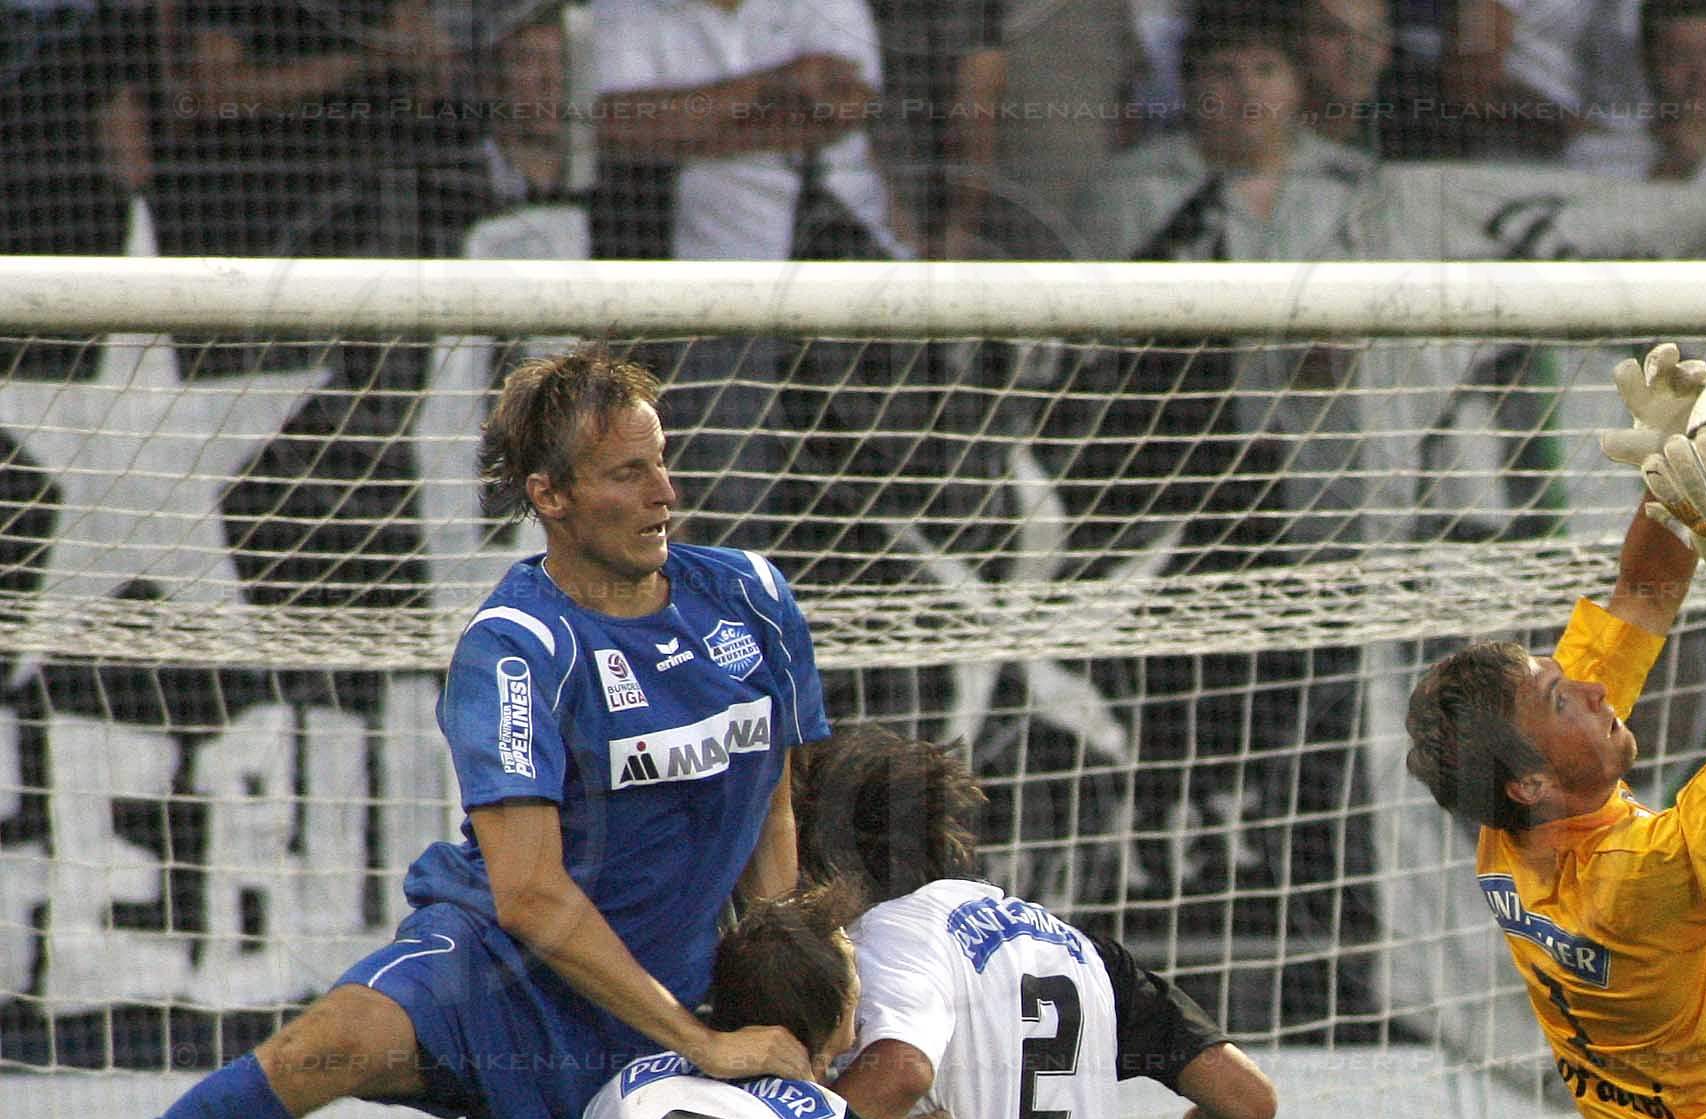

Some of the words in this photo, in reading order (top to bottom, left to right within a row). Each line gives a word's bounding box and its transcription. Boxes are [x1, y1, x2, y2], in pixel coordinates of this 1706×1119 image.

[656, 650, 694, 672] erima
[609, 692, 645, 708] LIGA
[510, 681, 533, 777] PIPELINES
[667, 717, 770, 777] MANA
